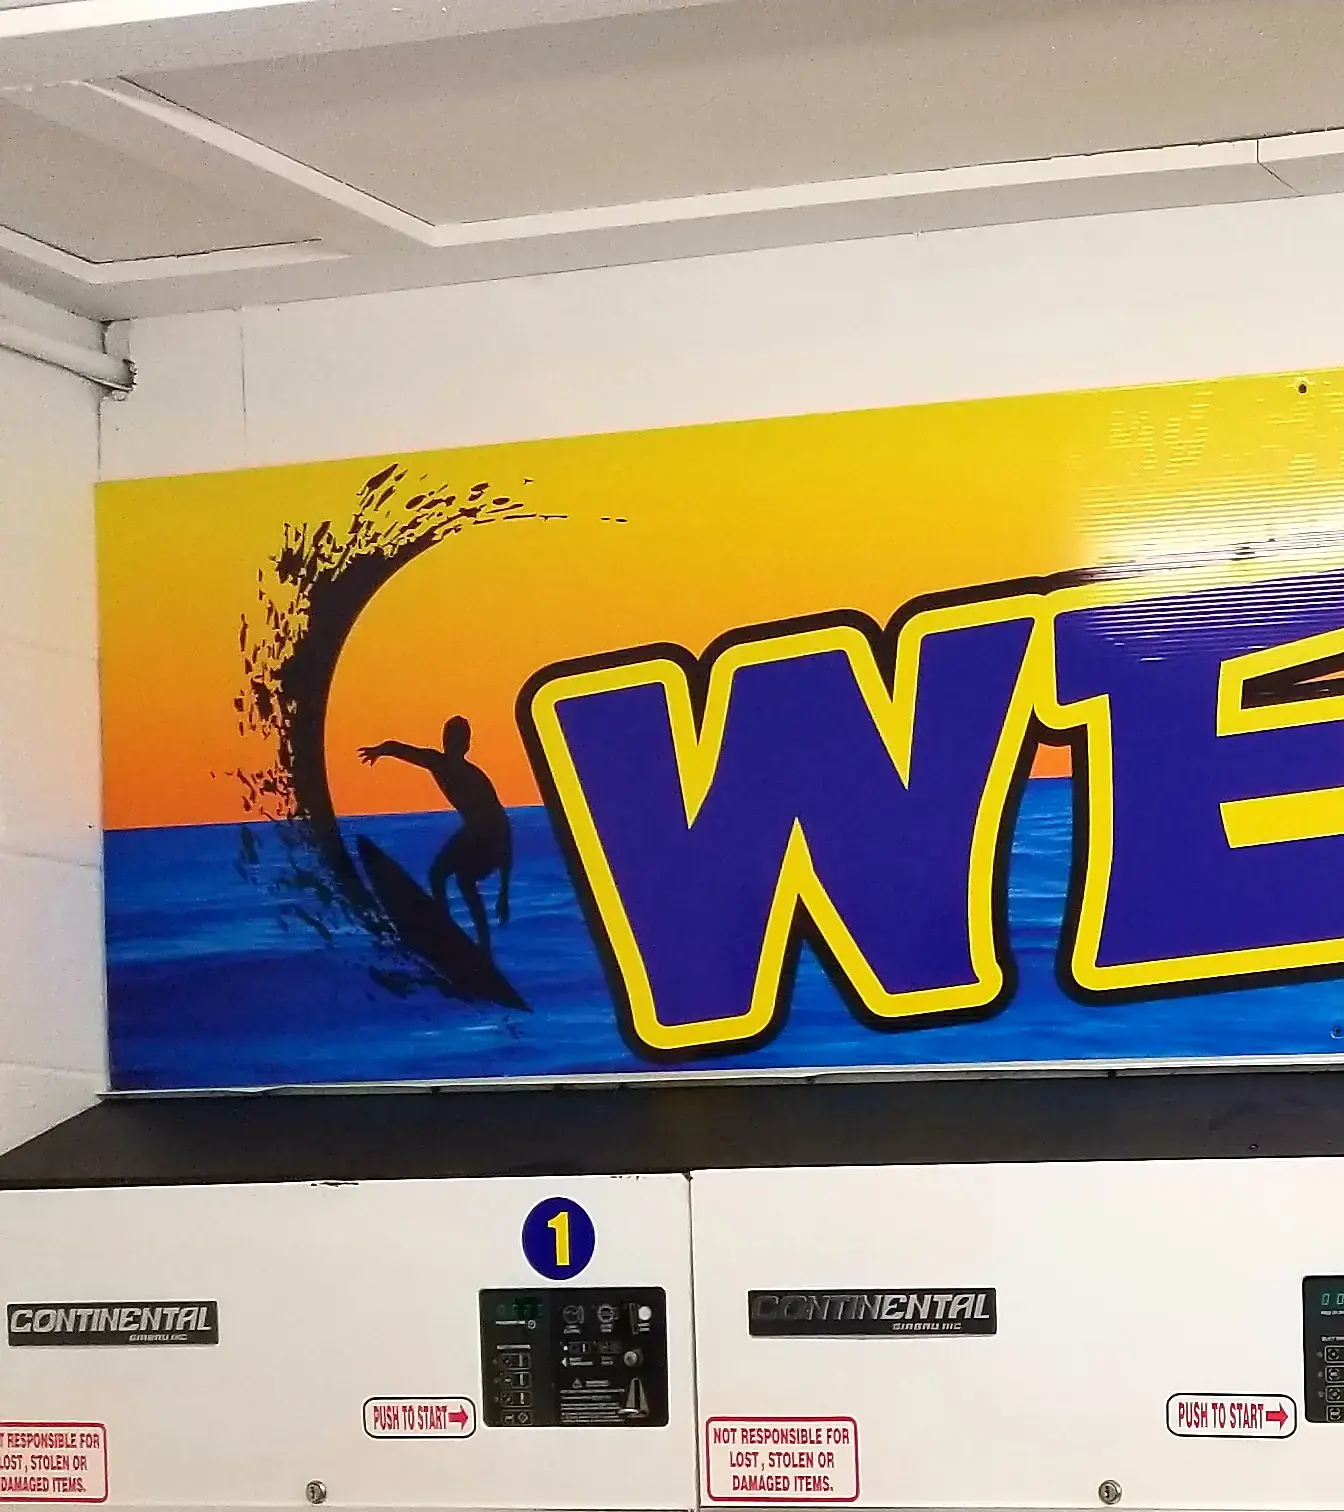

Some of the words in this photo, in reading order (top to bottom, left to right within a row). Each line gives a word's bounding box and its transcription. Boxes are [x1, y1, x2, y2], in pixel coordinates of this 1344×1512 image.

[547, 1211, 570, 1266] 1
[752, 1294, 990, 1320] CONTINENTAL
[10, 1307, 212, 1333] CONTINENTAL
[374, 1405, 400, 1430] PUSH
[402, 1405, 415, 1430] TO
[418, 1405, 447, 1430] START
[1178, 1402, 1209, 1430] PUSH
[1211, 1402, 1225, 1430] TO
[1229, 1402, 1264, 1430] START
[7, 1433, 77, 1448] RESPONSIBLE
[80, 1433, 100, 1449] FOR
[713, 1428, 738, 1446] NOT
[740, 1428, 823, 1446] RESPONSIBLE
[826, 1428, 850, 1446] FOR
[30, 1455, 70, 1471] STOLEN
[73, 1455, 88, 1471] OR
[767, 1452, 815, 1469] STOLEN
[817, 1452, 835, 1469] OR
[1, 1477, 50, 1492] DAMAGED
[53, 1477, 87, 1493] ITEMS.
[732, 1476, 791, 1492] DAMAGED
[794, 1476, 834, 1492] ITEMS.
